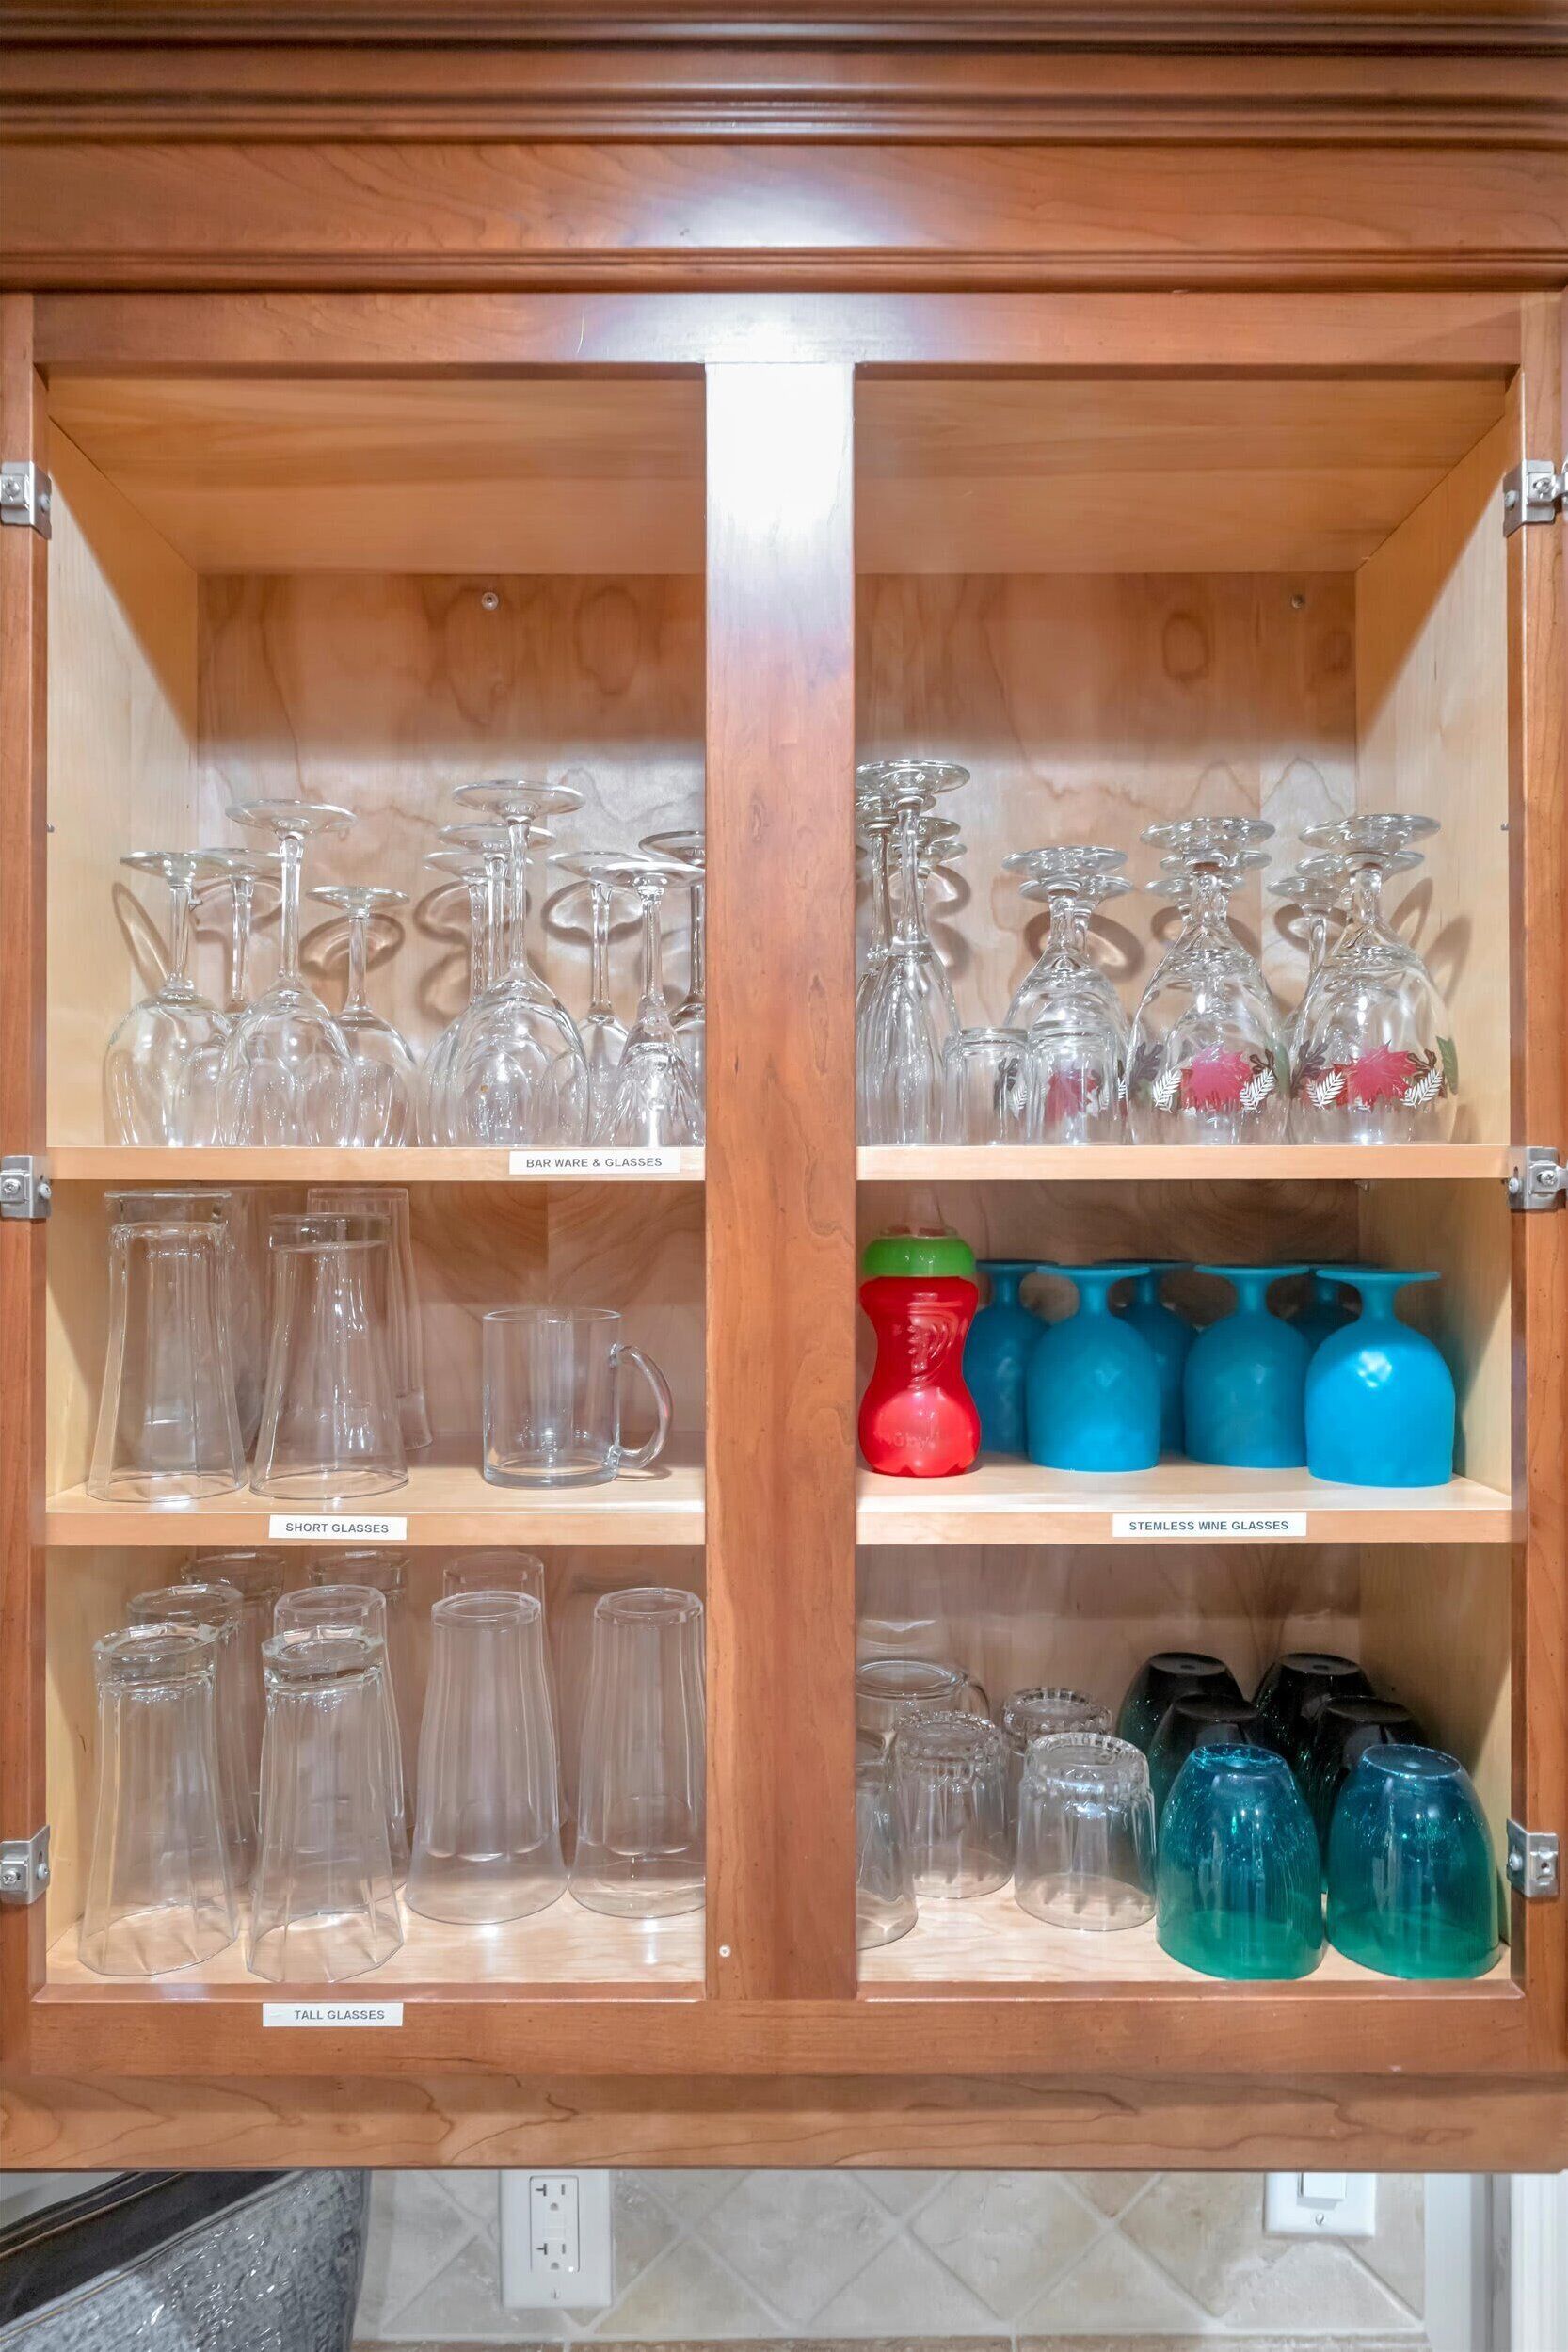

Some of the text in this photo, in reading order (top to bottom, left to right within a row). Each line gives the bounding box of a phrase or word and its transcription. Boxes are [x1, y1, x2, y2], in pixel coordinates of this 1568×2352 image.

[525, 1157, 664, 1168] BAR WARE & GLASSES
[285, 1522, 389, 1534] SHORT GLASSES
[1128, 1520, 1288, 1531] STEMLESS WINE GLASSES
[295, 2009, 385, 2020] TALL GLASSES
